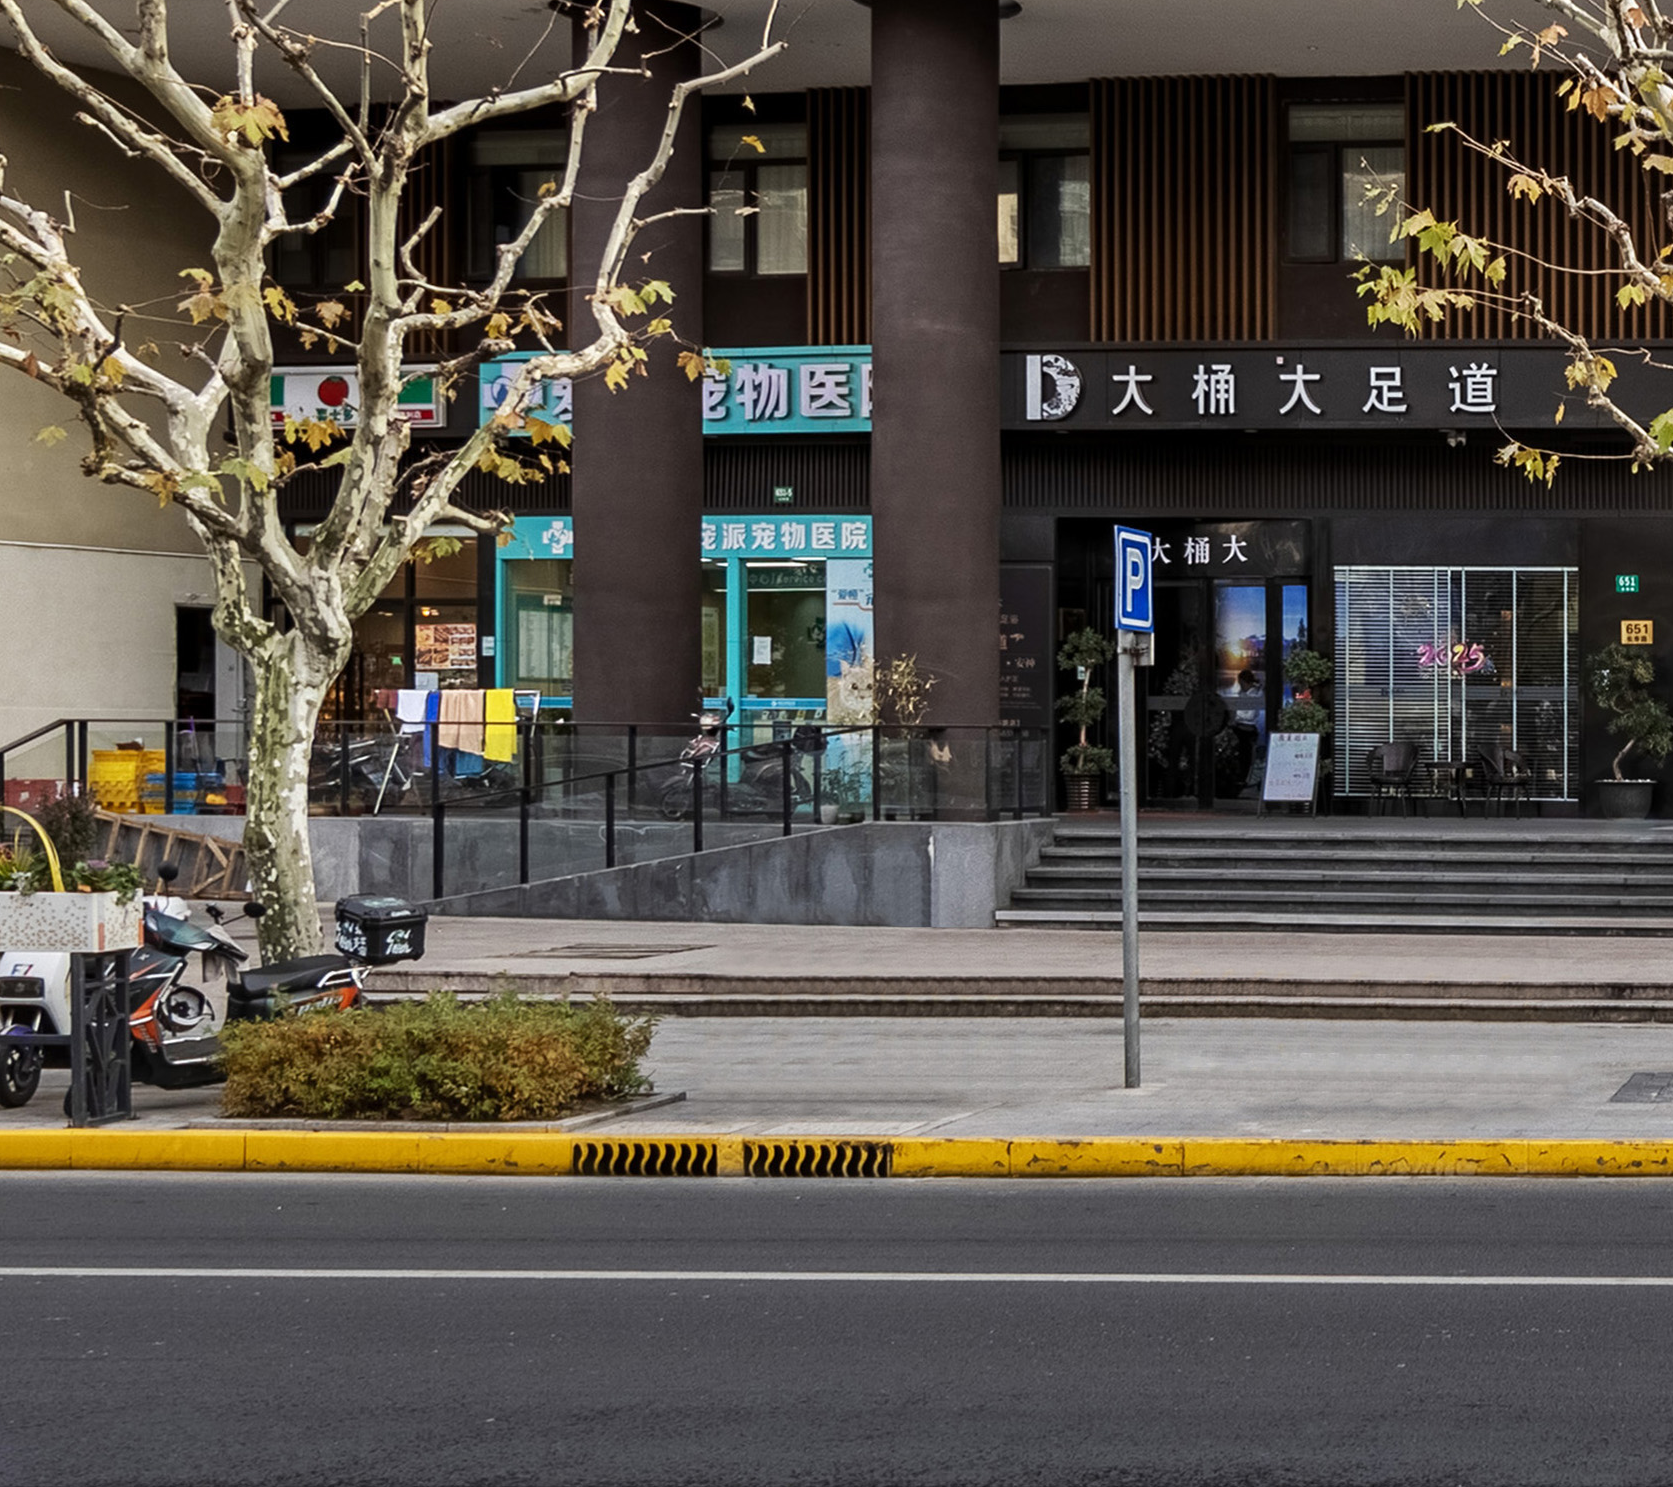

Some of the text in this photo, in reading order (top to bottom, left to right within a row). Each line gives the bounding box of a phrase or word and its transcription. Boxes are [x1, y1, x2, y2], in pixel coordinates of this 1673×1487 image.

[1111, 361, 1499, 416] 大桶大足道
[1126, 547, 1145, 613] P
[1618, 576, 1636, 586] 651
[1626, 623, 1648, 634] 651
